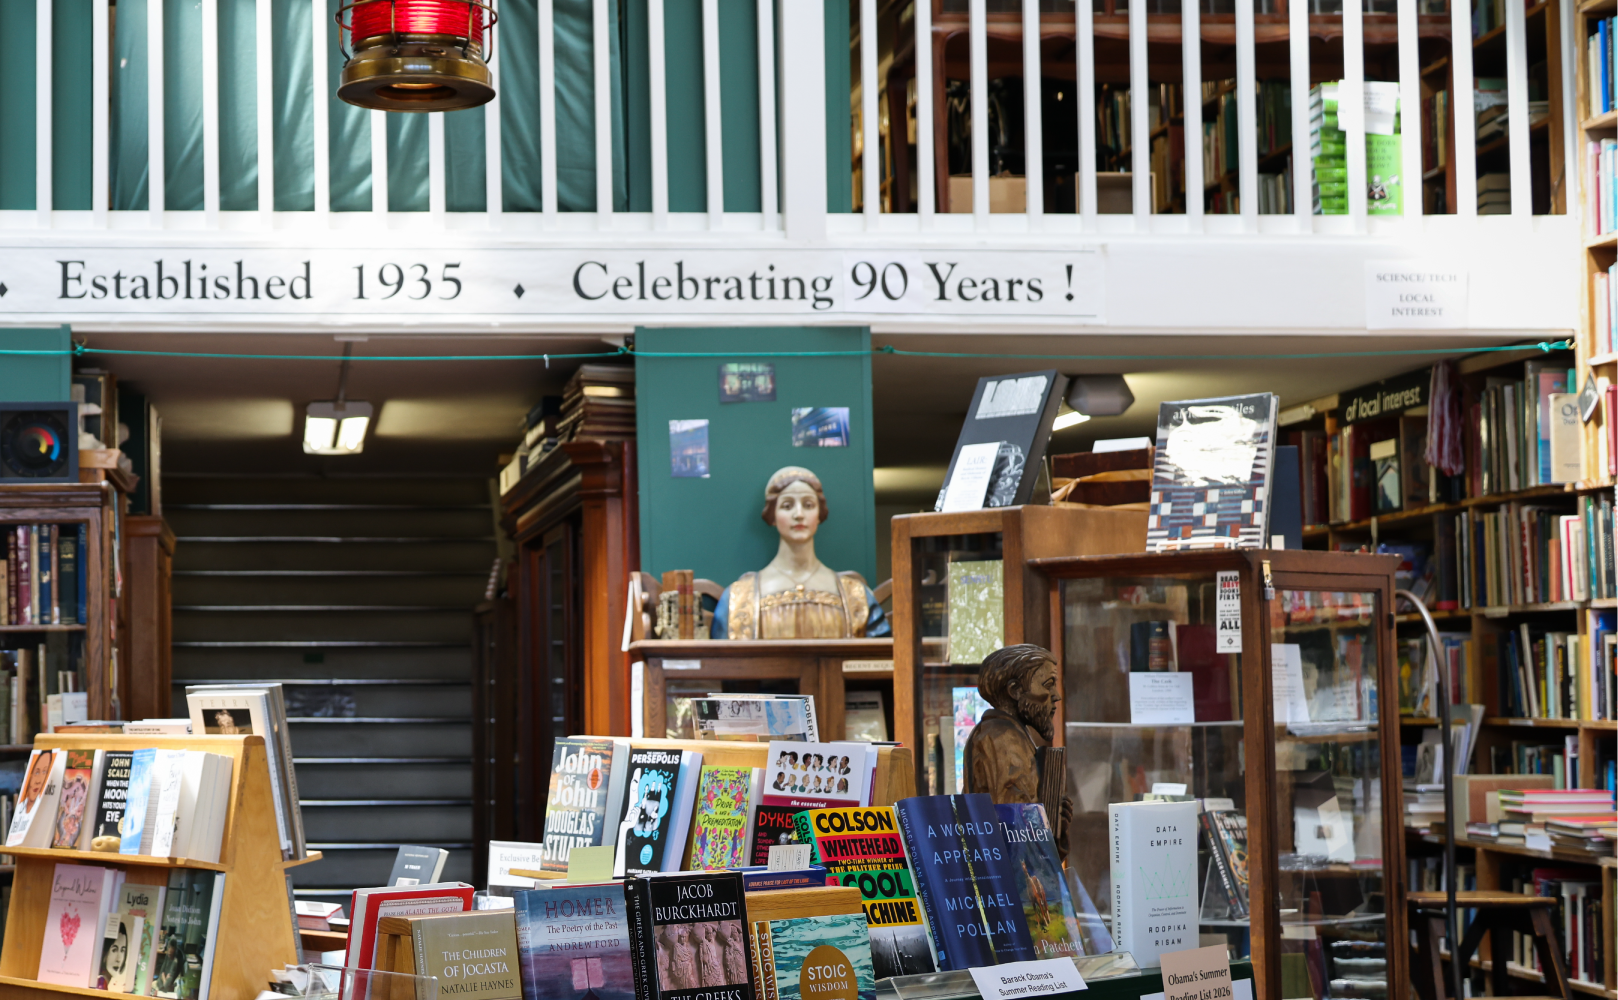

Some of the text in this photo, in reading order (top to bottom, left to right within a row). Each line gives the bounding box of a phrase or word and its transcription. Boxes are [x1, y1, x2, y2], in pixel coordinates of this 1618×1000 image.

[56, 258, 463, 301] Established 1935
[572, 260, 834, 310] Celebrating
[851, 261, 909, 301] 90
[926, 262, 1044, 302] Years
[1376, 272, 1456, 283] SCIENCE/ TECH
[1399, 293, 1435, 303] LOCAL
[1391, 307, 1443, 317] INTEREST
[1346, 385, 1421, 422] of local interest
[1219, 593, 1240, 601] FIRST
[1220, 620, 1240, 631] ALL
[803, 697, 815, 738] ROBERT
[111, 758, 130, 768] JOHN
[555, 746, 602, 774] John
[631, 753, 680, 765] PERSEPOLIS
[107, 768, 130, 778] SCALZI
[563, 774, 576, 786] OF
[103, 789, 128, 800] MOON
[551, 779, 598, 808] John
[102, 801, 127, 810] HITS YOUR
[105, 810, 121, 823] EYE
[547, 809, 595, 835] DOUGLAS
[758, 811, 795, 829] DYKE
[815, 811, 894, 834] COLSON
[928, 821, 994, 838] A WORLD
[999, 821, 1050, 843] histler
[799, 816, 818, 863] COLSON
[821, 837, 899, 858] WHITEHEAD
[900, 808, 912, 845] MICHAEL
[911, 846, 923, 878] POLLAN
[1150, 838, 1183, 847] EMPIRE
[499, 853, 531, 863] Exclusive
[933, 848, 1002, 865] APPEARS
[830, 866, 845, 874] THE
[126, 892, 149, 907] Lydia
[677, 884, 714, 903] JACOB
[544, 897, 616, 919] HOMER
[655, 901, 738, 921] BURCKHARDT
[945, 893, 1015, 912] MICHAEL
[862, 900, 918, 925] ACHINE
[546, 921, 618, 934] The Poetry of the Past
[956, 919, 1017, 938] POLLAN
[1148, 924, 1187, 934] ROOPIKA
[549, 938, 620, 952] ANDREW FORD
[635, 911, 644, 940] GREEKS
[640, 960, 648, 983] GREEK
[1041, 937, 1083, 956] Patchett
[1155, 938, 1182, 947] RISAM
[441, 948, 507, 961] THE CHILDREN
[749, 934, 759, 973] STOIC
[444, 962, 509, 979] OF JOCASTA
[761, 932, 776, 1000] STOIC WIS
[807, 963, 847, 981] STOIC
[1000, 971, 1054, 985] Barack Obama's
[1167, 968, 1228, 986] Obama's Summer
[441, 979, 514, 995] NATALIE HAYNES
[809, 981, 849, 993] WISDOM
[998, 981, 1068, 997] Summer Reading List
[1199, 986, 1231, 1000] List 2026
